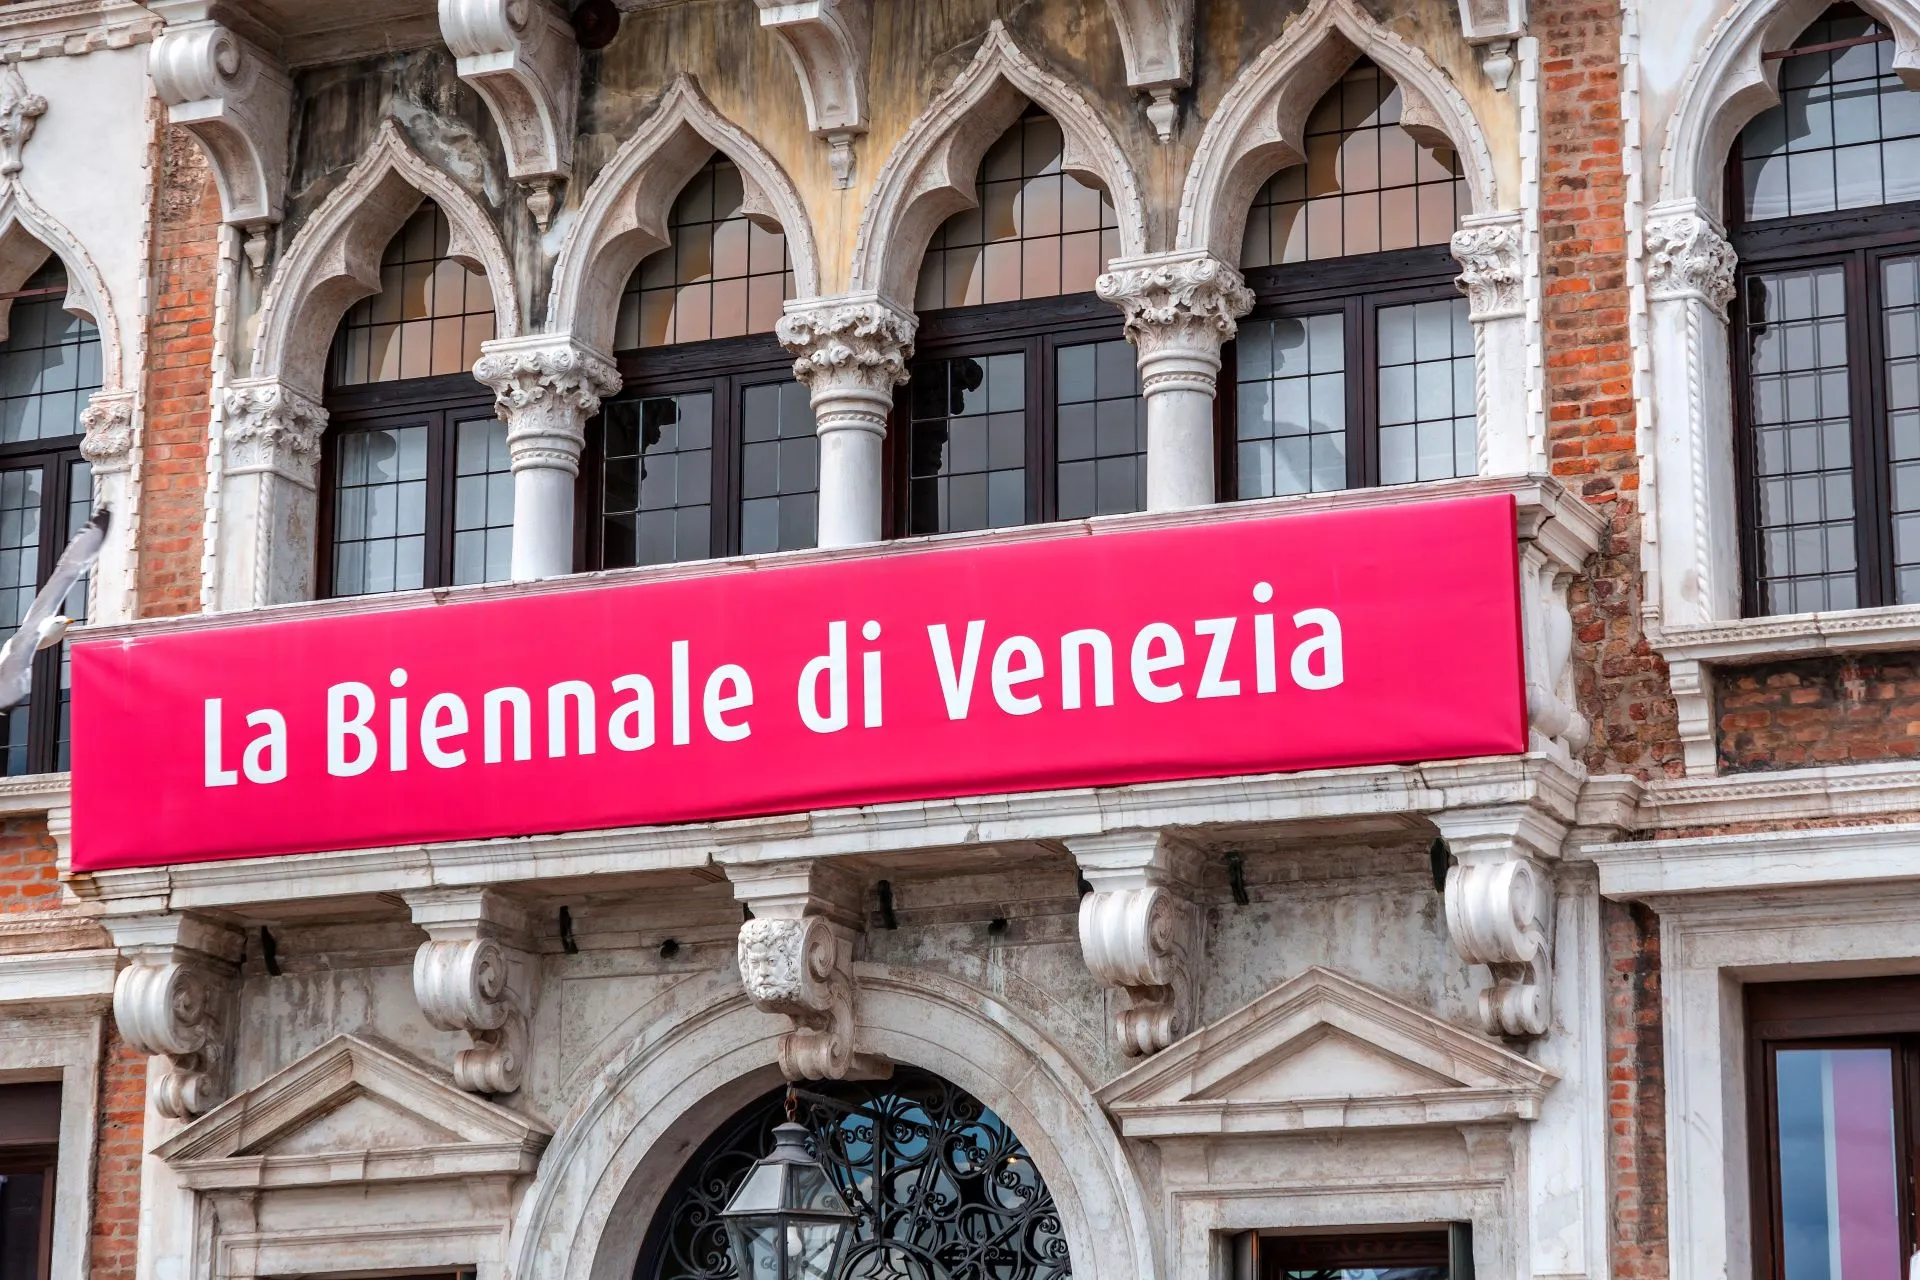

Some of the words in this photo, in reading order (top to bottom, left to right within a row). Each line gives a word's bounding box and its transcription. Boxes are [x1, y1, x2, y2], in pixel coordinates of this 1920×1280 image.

[204, 697, 287, 787] La
[327, 640, 753, 777] Biennale
[798, 620, 882, 734] di
[927, 582, 1344, 720] Venezia
